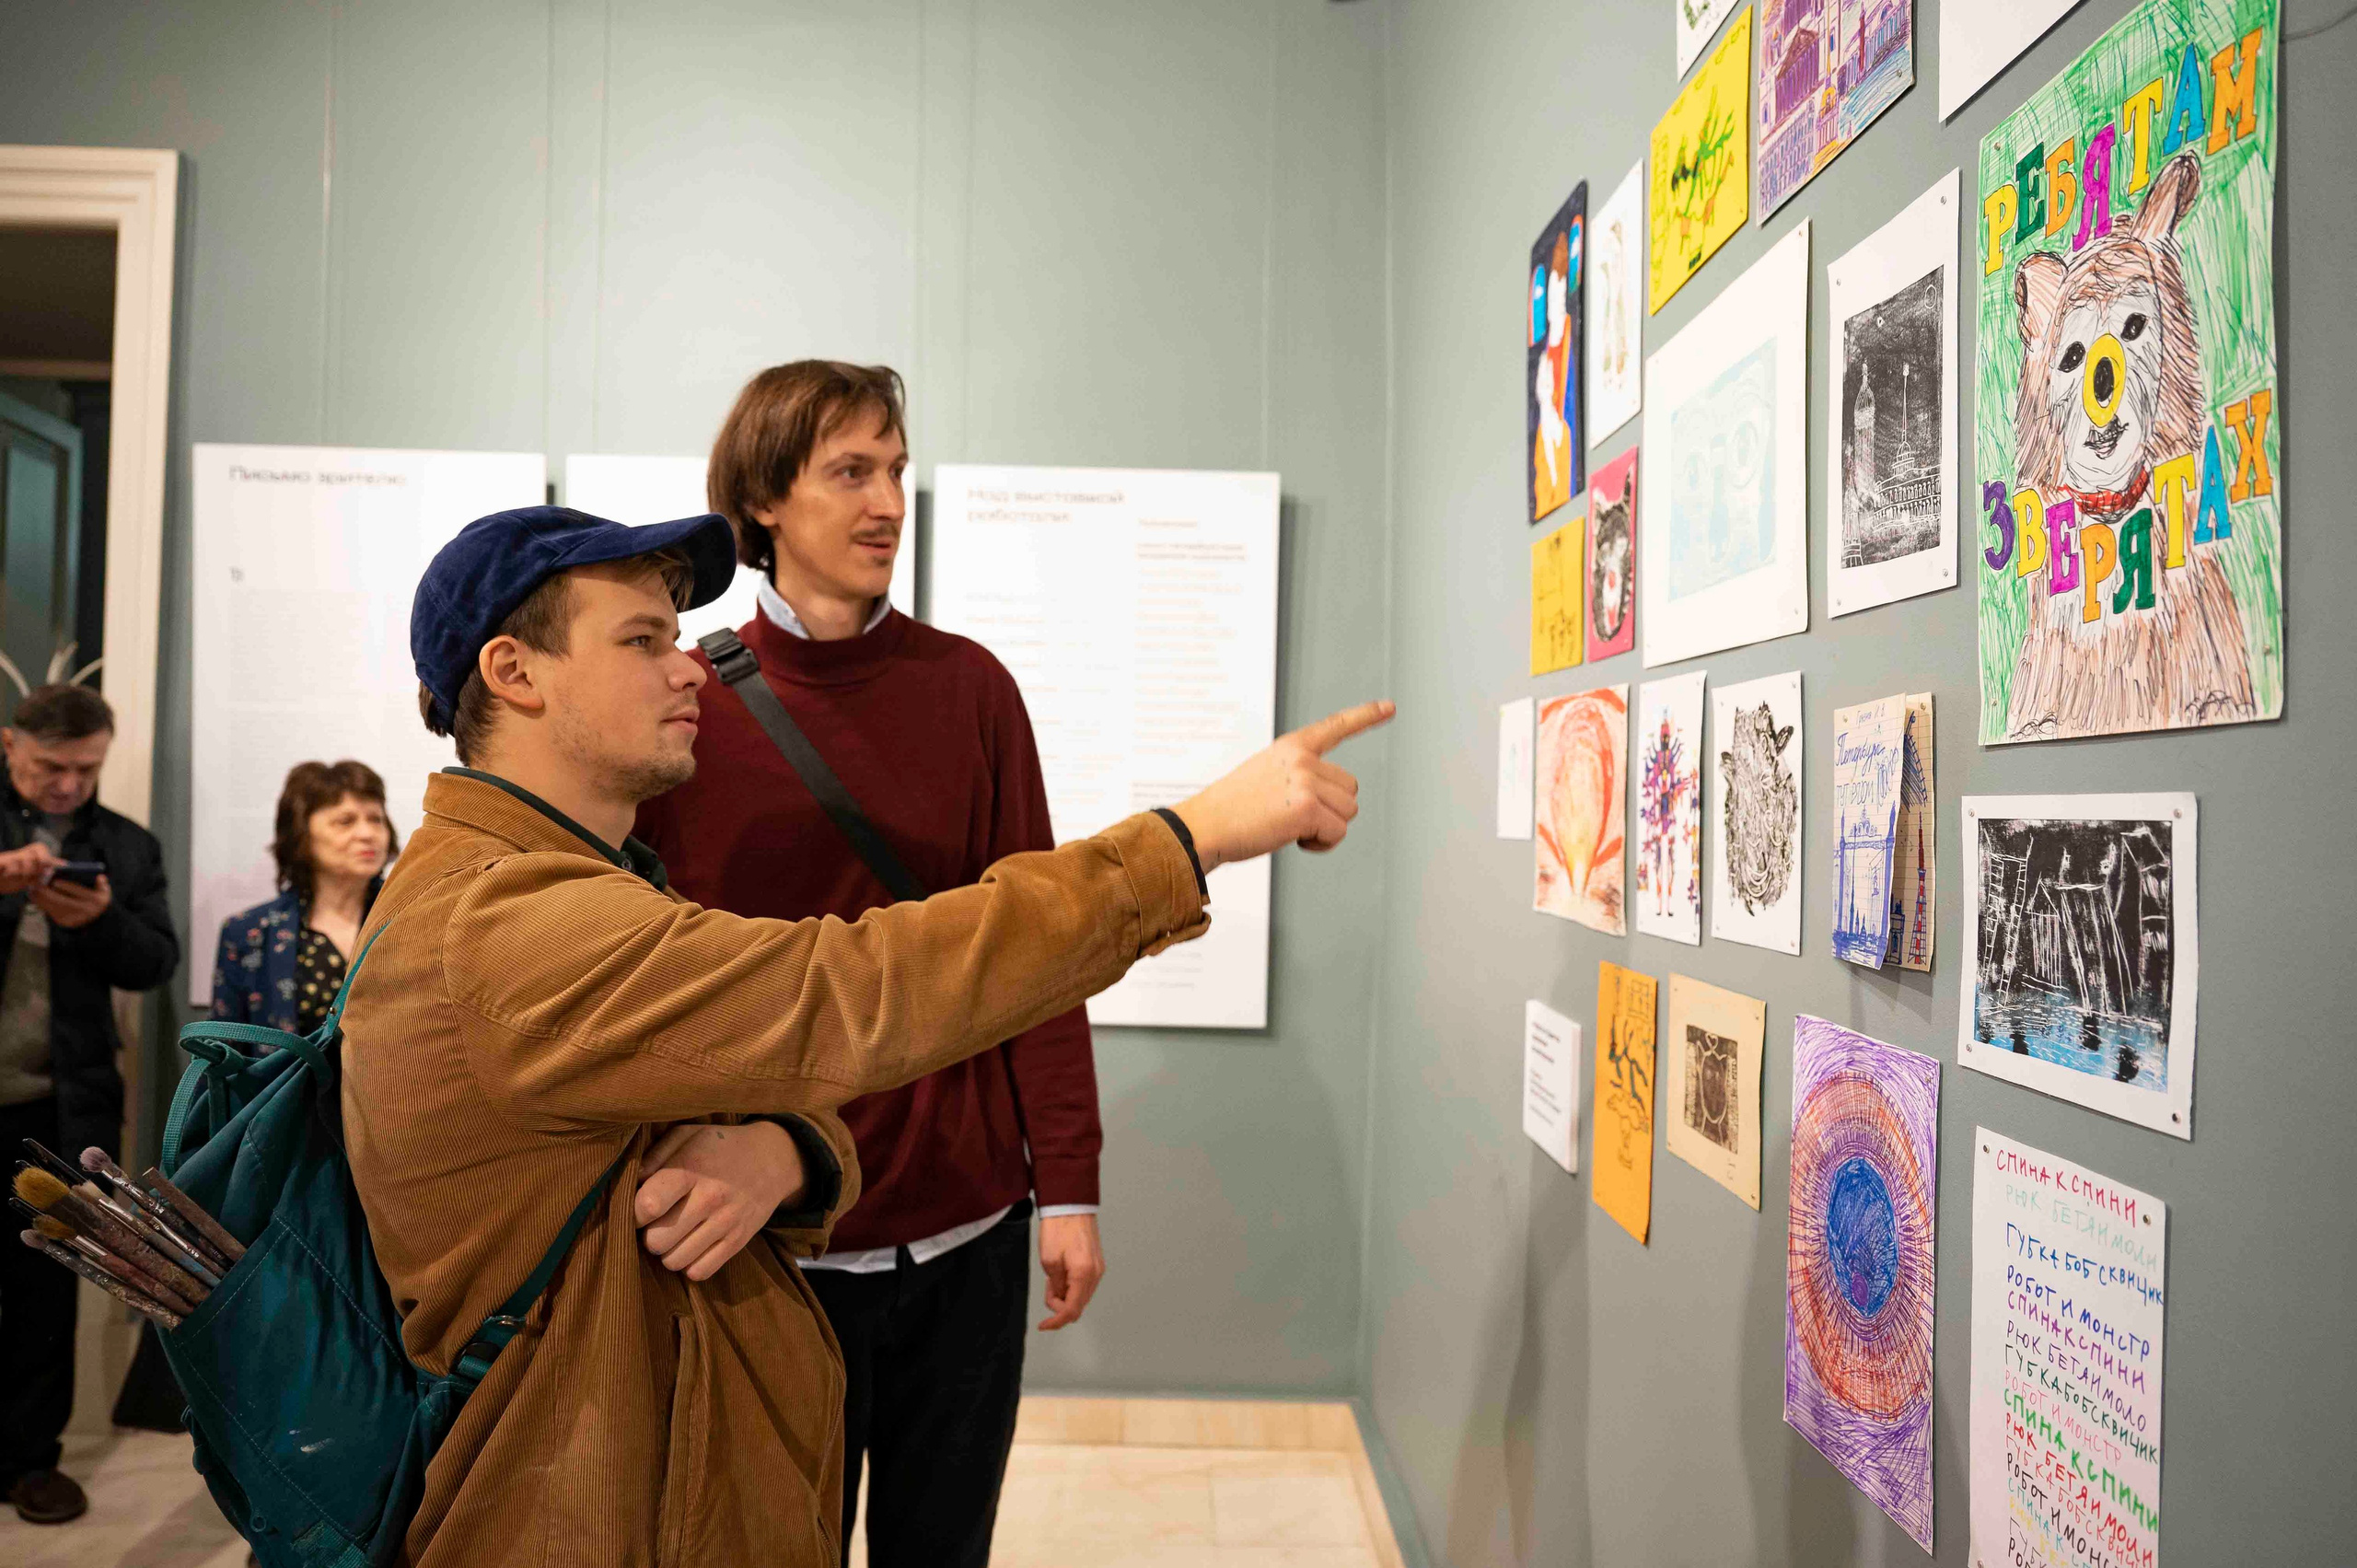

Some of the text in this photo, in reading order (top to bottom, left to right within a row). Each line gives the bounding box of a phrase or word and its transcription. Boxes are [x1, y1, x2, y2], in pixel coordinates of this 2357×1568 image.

[1983, 25, 2263, 278] РЕБЯТАМ
[1983, 389, 2273, 624] ЗВЕРЯТАХ
[1996, 1149, 2050, 1185] СПИНА
[2056, 1171, 2067, 1191] К
[2006, 1222, 2060, 1270] ГУБКА
[2065, 1251, 2097, 1279] БОБ
[2007, 1265, 2057, 1307] РОБОТ
[2079, 1308, 2150, 1363] МОНСТР
[2007, 1291, 2061, 1338] СПИНА
[2064, 1327, 2075, 1348] К
[2007, 1319, 2041, 1355] РЮК
[2005, 1343, 2062, 1395] ГУБКА
[2064, 1382, 2093, 1413] БОБ
[2004, 1388, 2067, 1452] СПИНА
[2072, 1448, 2084, 1480] К
[2005, 1369, 2049, 1411] РОБОТ
[2064, 1416, 2121, 1466] МОНСТР
[2005, 1412, 2037, 1451] РЮК
[2005, 1434, 2055, 1490] ГУБКА
[2058, 1486, 2087, 1524] БОБ
[2007, 1452, 2049, 1510] РОБОТ
[2008, 1477, 2051, 1539] СПИНА
